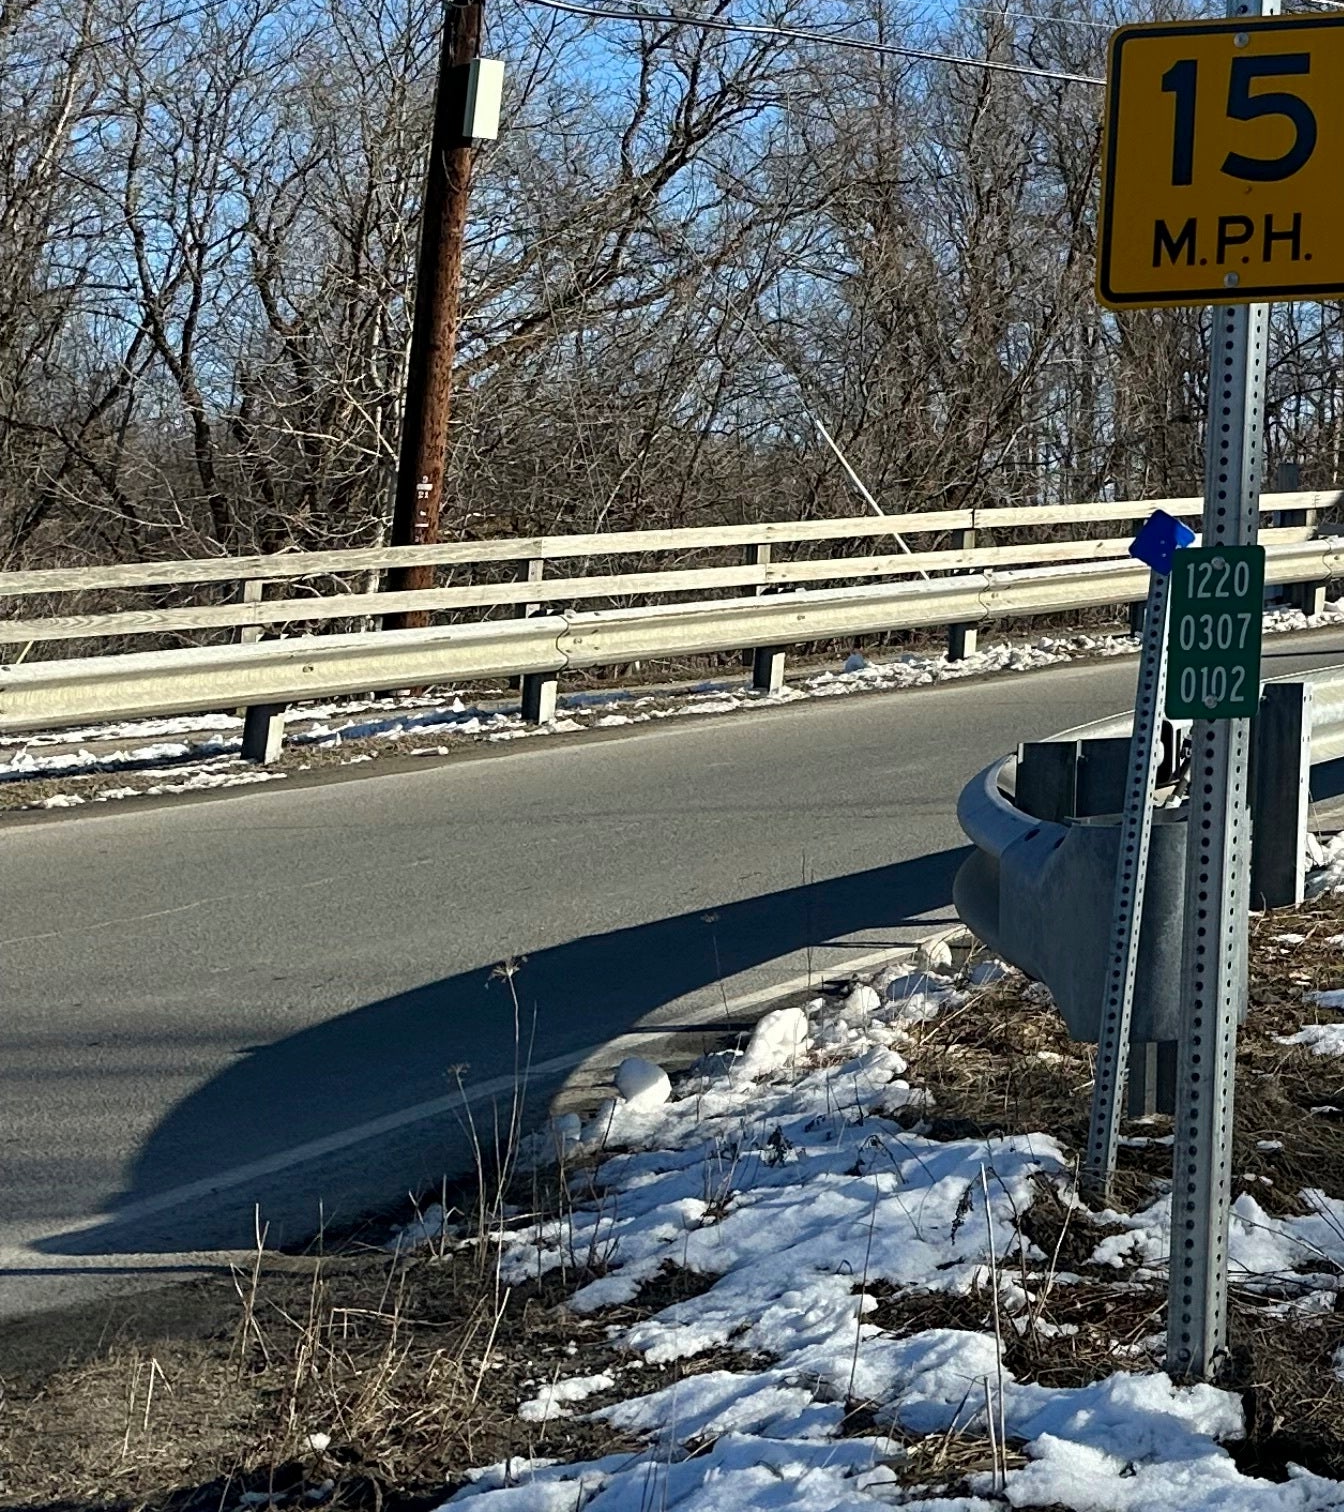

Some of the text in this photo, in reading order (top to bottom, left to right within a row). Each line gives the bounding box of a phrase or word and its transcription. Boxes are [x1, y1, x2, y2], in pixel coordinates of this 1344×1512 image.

[1161, 52, 1318, 186] 15
[1152, 212, 1312, 268] M.P.H.
[1186, 560, 1250, 599] 1220
[1179, 613, 1252, 651] 0307
[1180, 665, 1246, 704] 0102
